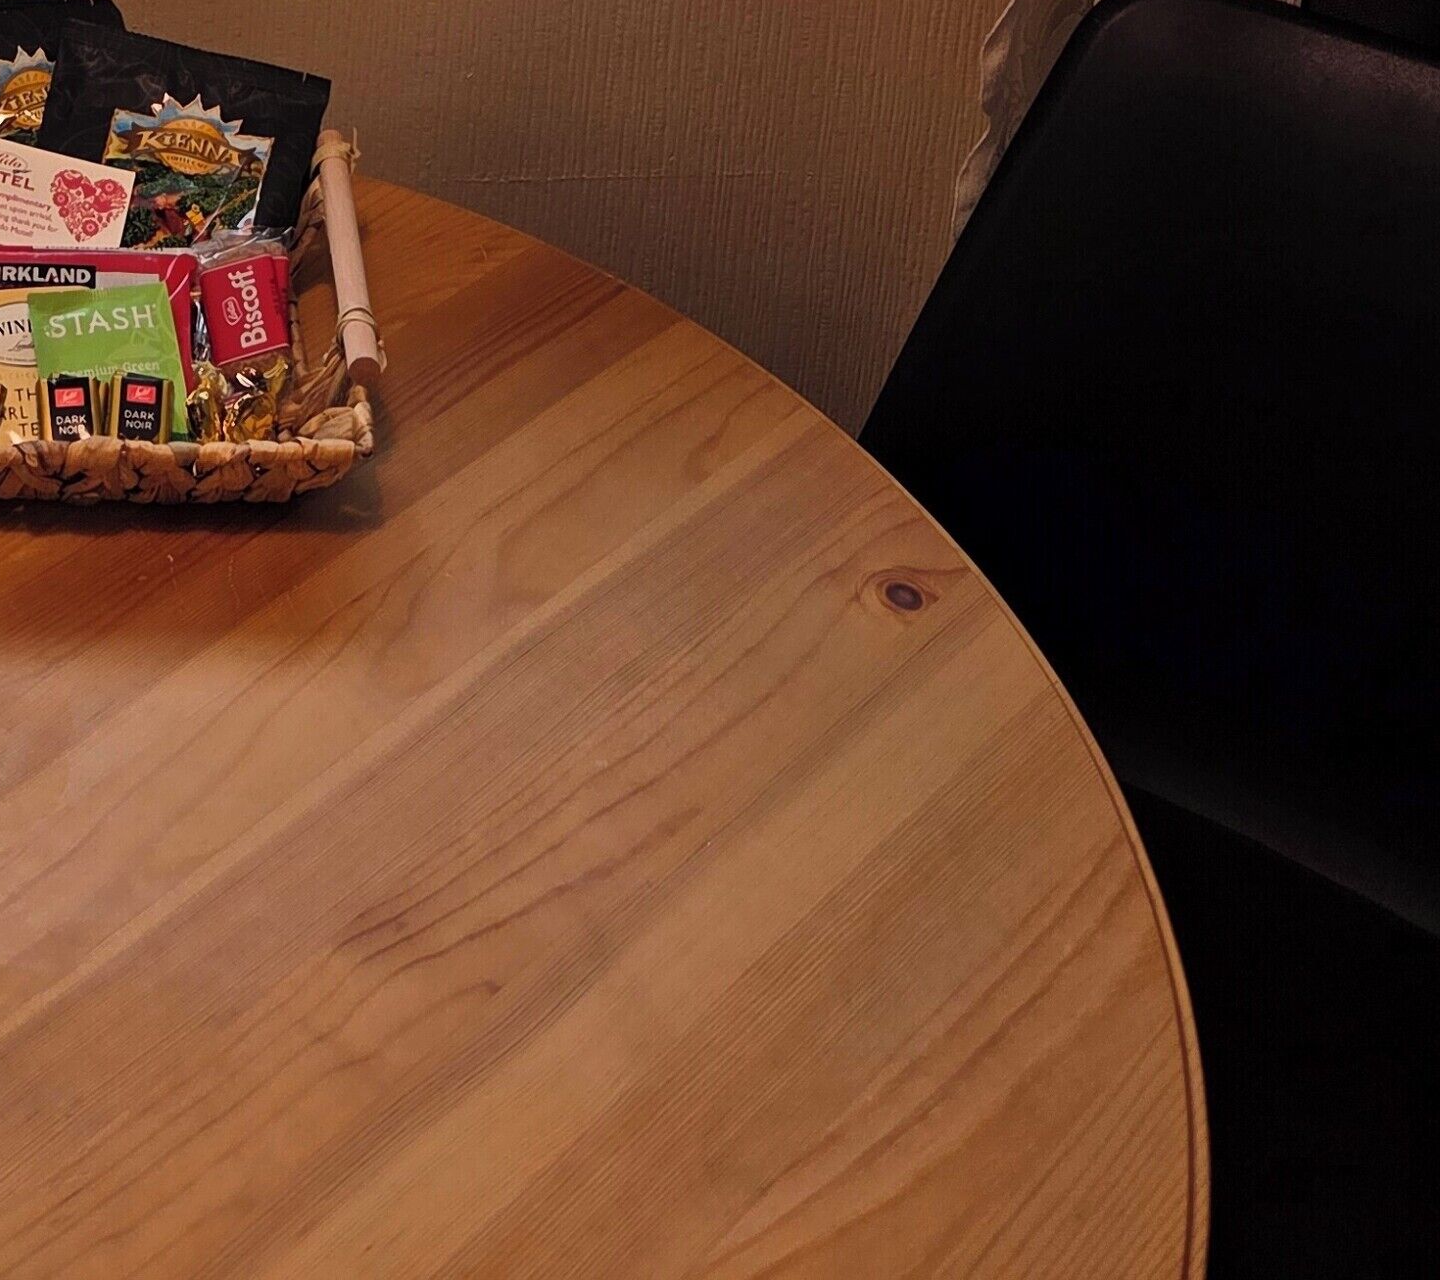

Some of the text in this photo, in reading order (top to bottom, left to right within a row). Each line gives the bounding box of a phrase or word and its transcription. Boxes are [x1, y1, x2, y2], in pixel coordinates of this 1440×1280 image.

[137, 131, 242, 166] KIENNA
[48, 304, 155, 338] STASH
[122, 361, 160, 373] Green
[56, 415, 87, 425] DARK
[124, 410, 155, 420] DARK
[125, 420, 153, 430] NOIR
